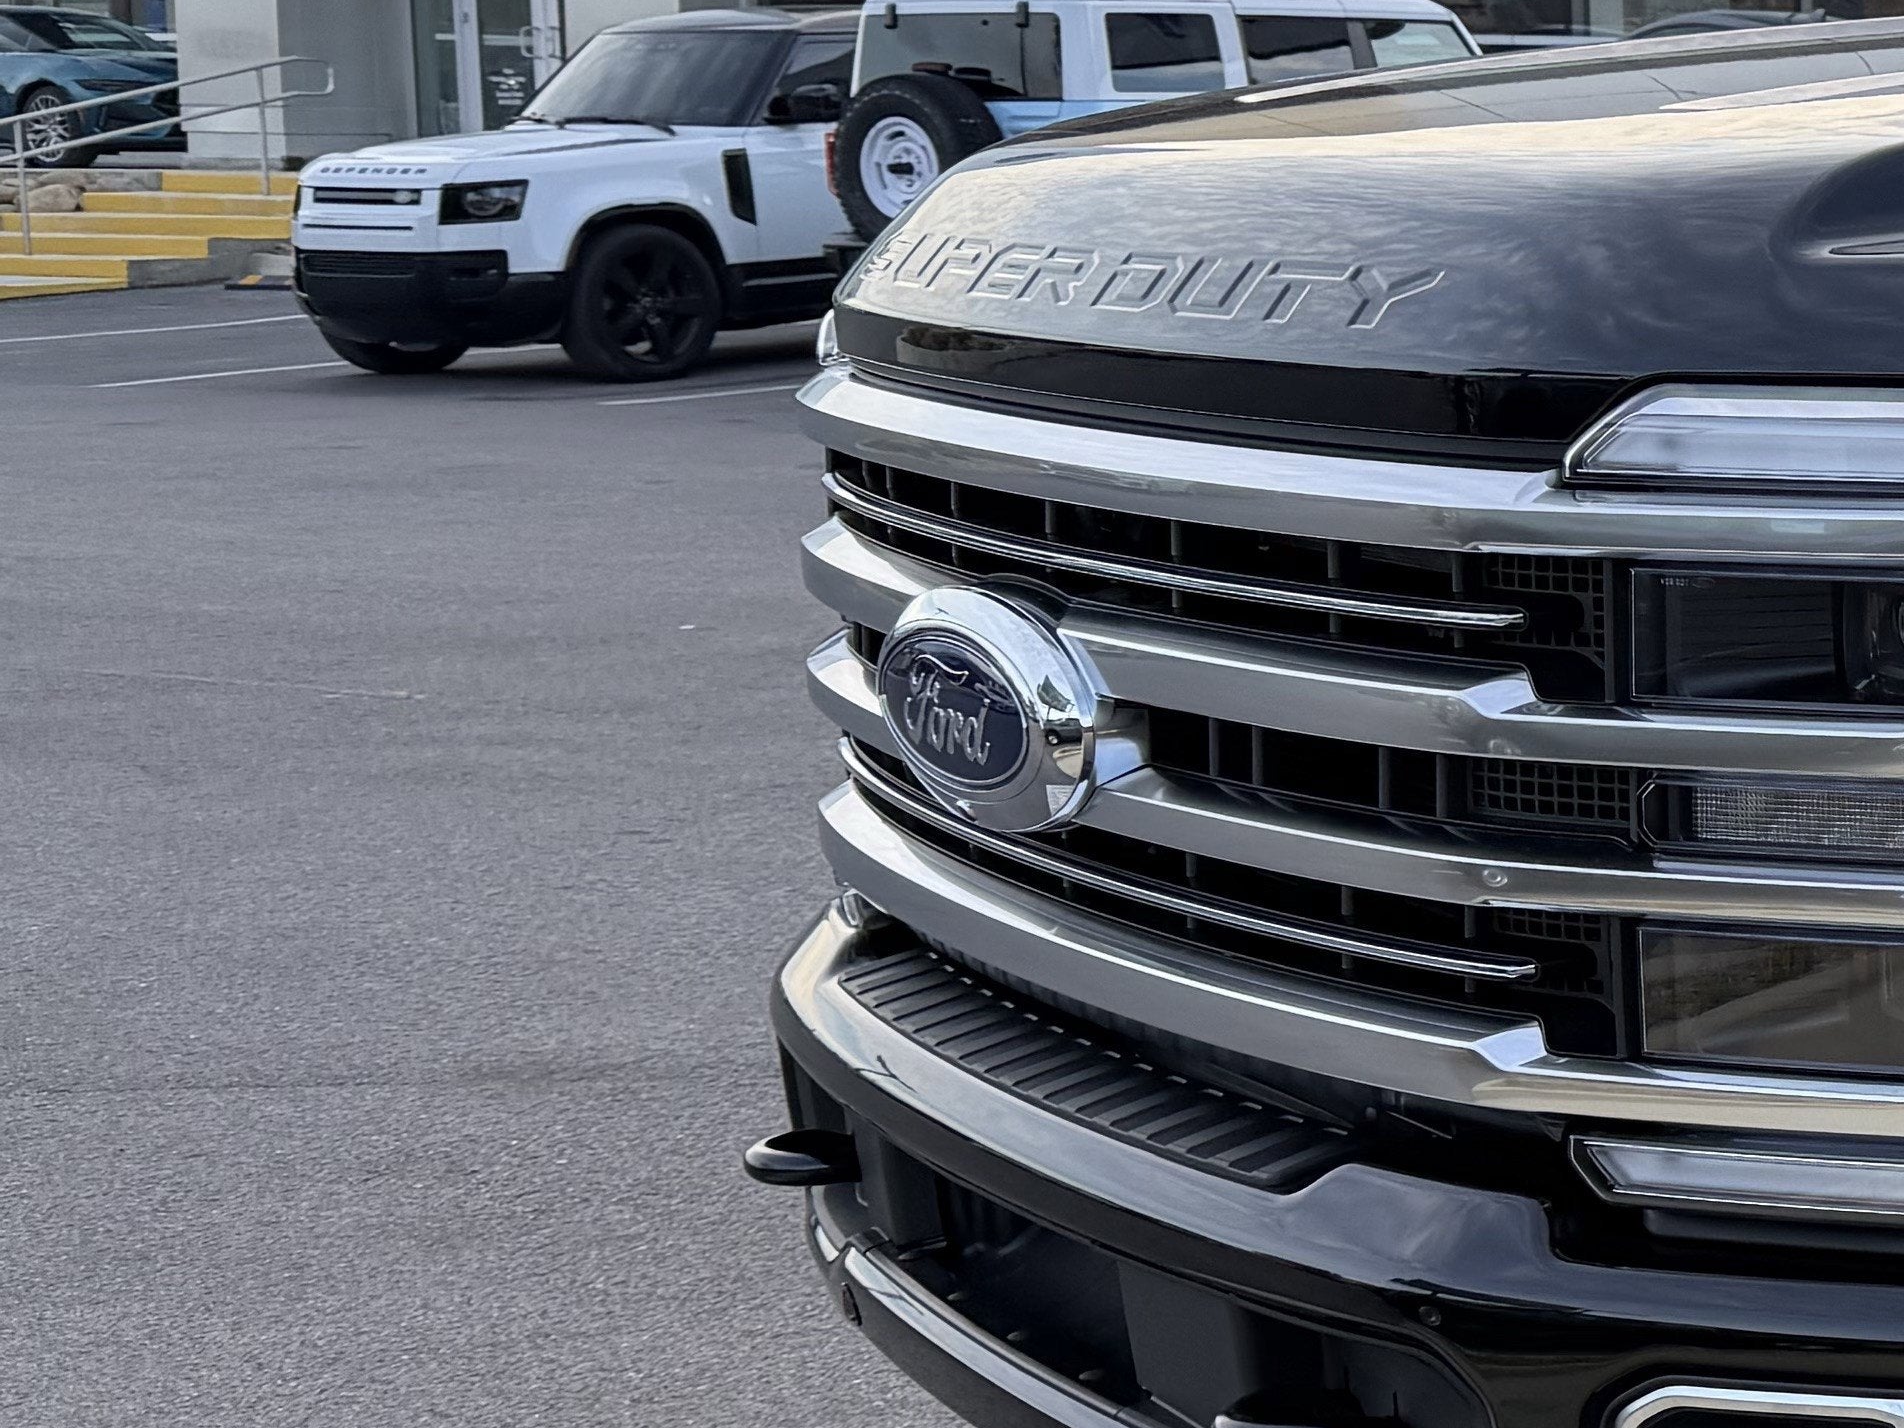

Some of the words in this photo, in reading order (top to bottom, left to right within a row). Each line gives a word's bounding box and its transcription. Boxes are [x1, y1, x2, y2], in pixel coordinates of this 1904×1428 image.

[861, 233, 1099, 306] SUPER
[1090, 251, 1444, 329] DUTY
[904, 654, 991, 766] Ford
